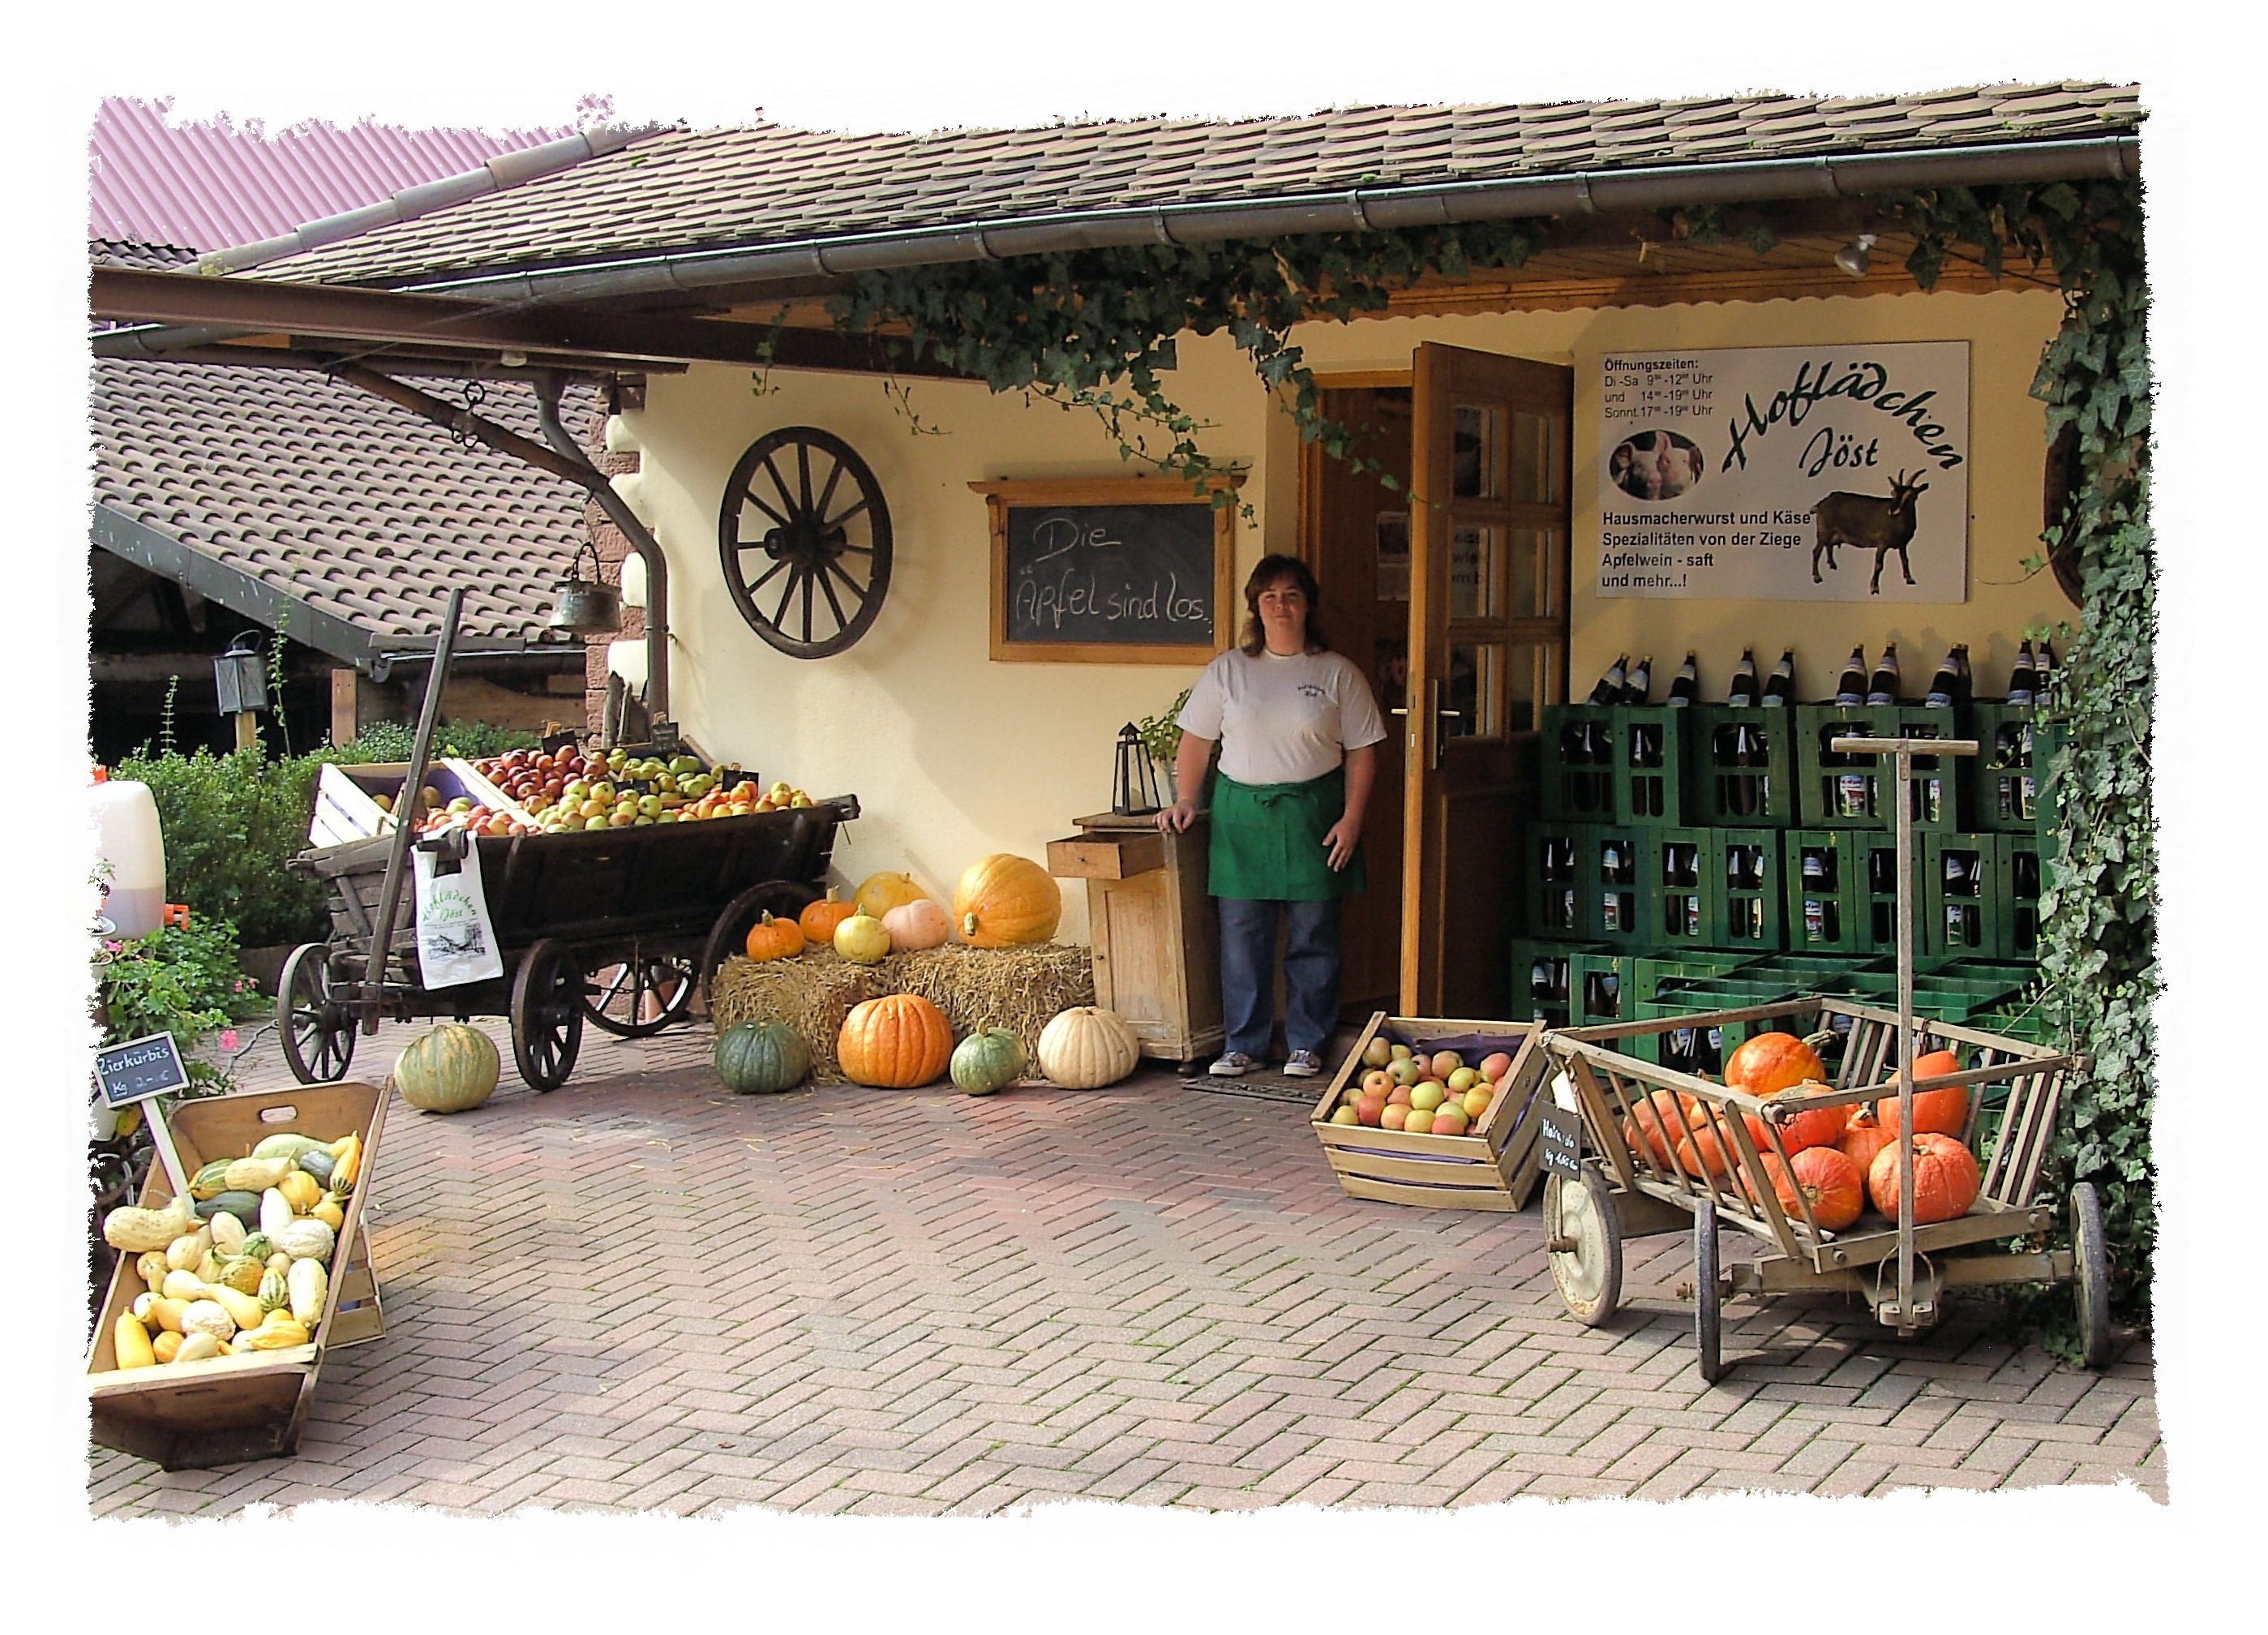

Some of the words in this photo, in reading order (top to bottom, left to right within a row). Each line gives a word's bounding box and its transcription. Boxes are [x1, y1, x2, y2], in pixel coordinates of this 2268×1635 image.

[1605, 358, 1699, 372] Öffnungszeiten:
[1605, 375, 1616, 387] Di
[1693, 373, 1713, 384] Uhr
[1605, 392, 1625, 402] und
[1693, 389, 1713, 400] Uhr
[1693, 405, 1713, 416] Uhr
[1721, 361, 1963, 474] Hoflädchen
[1799, 427, 1878, 477] Jöst
[1603, 512, 1735, 525] Hausmacherwurst
[1740, 511, 1768, 524] und
[1773, 510, 1811, 524] Käse
[1033, 517, 1121, 562] Die
[1602, 532, 1695, 548] Spezialitäten
[1700, 535, 1726, 545] von
[1731, 532, 1755, 546] der
[1760, 532, 1801, 548] Ziege
[1602, 553, 1672, 569] Apfelwein
[1687, 552, 1713, 566] saft
[1602, 574, 1628, 587] und
[1633, 573, 1687, 587] mehr...!
[1017, 568, 1100, 629] Äpfel
[1107, 580, 1159, 621] sind
